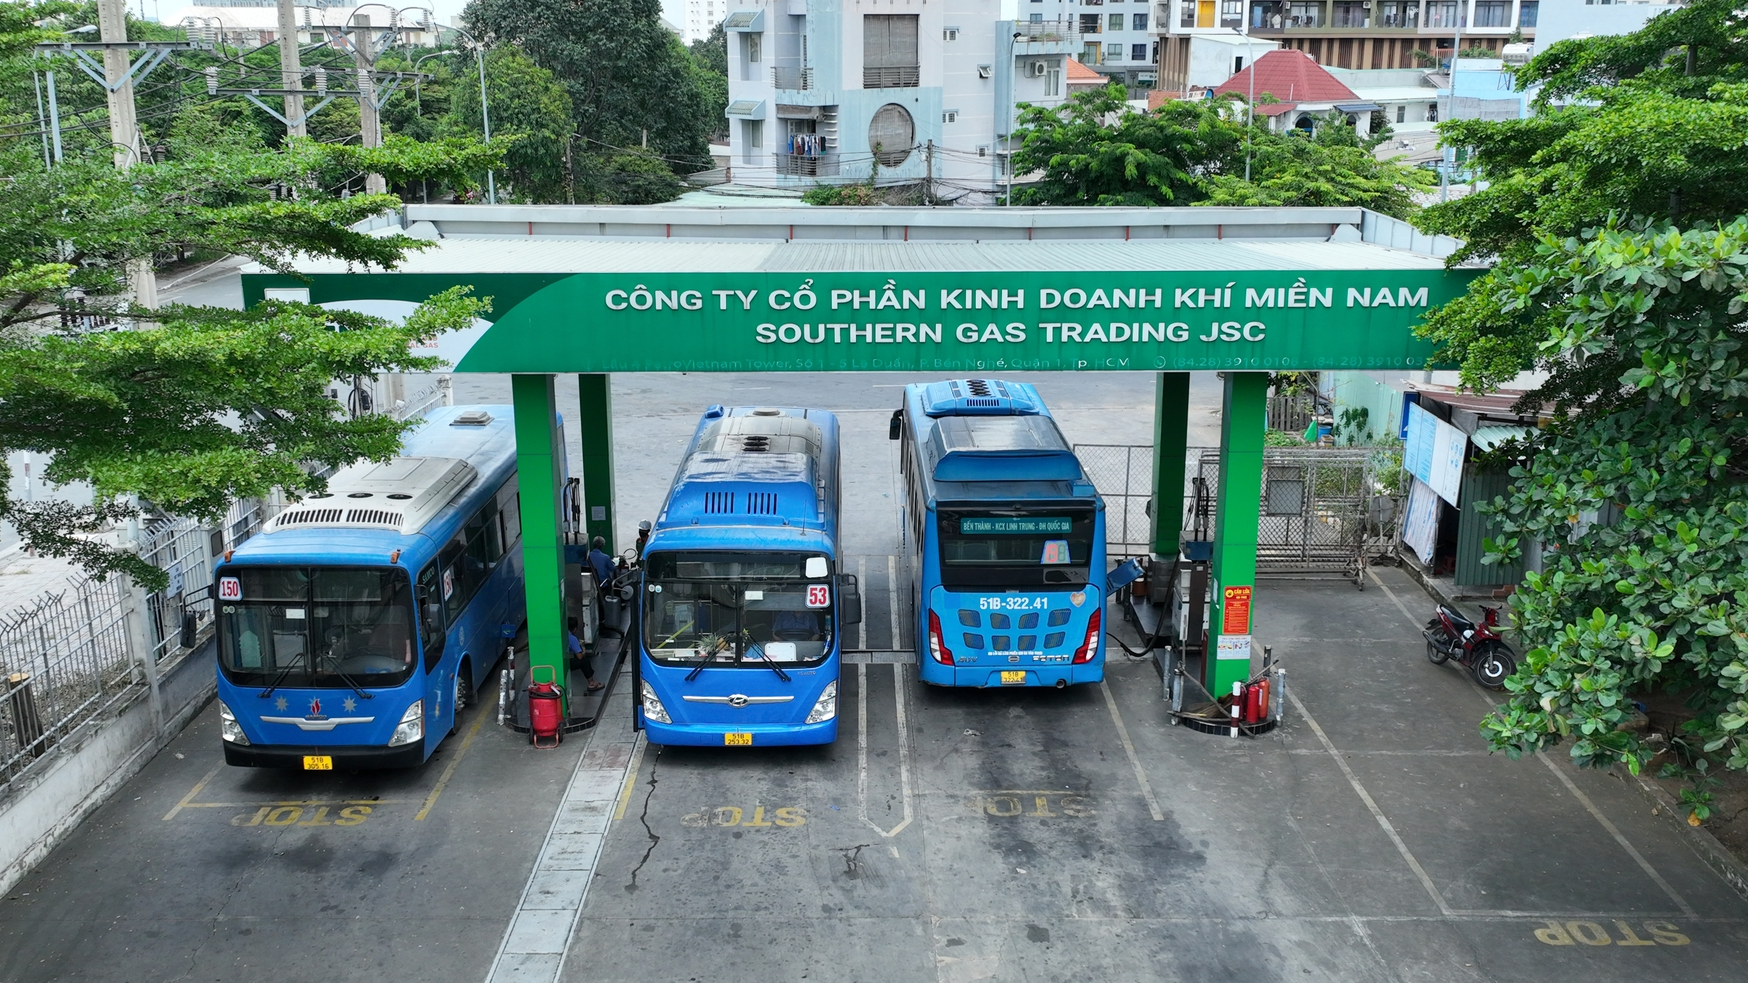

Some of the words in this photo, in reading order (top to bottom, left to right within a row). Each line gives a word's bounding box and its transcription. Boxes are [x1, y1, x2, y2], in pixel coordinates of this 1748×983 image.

[605, 284, 703, 310] CÔNG
[711, 289, 758, 310] TY
[768, 278, 817, 310] CỔ
[831, 279, 926, 310] PHẦN
[940, 289, 1025, 309] KINH
[1039, 288, 1162, 309] DOANH
[1174, 281, 1236, 308] KHÍ
[1245, 277, 1333, 308] MIỀN
[1346, 287, 1429, 308] NAM
[755, 323, 942, 343] SOUTHERN
[956, 322, 1026, 343] GAS
[1038, 322, 1189, 343] TRADING
[1199, 321, 1266, 342] JSC
[965, 357, 1008, 370] Nghé,
[1224, 357, 1260, 367] 3910
[1366, 356, 1402, 367] 3910
[974, 520, 992, 531] THÀNH
[995, 522, 1006, 531] KCX
[1006, 522, 1018, 531] LINH
[1018, 522, 1036, 531] TRUNG
[1061, 522, 1070, 531] GIA
[220, 580, 239, 597] 150
[808, 587, 827, 605] 53
[979, 597, 1048, 610] 51B-322.41
[230, 805, 373, 827] STOP
[1533, 919, 1692, 947] STOP
